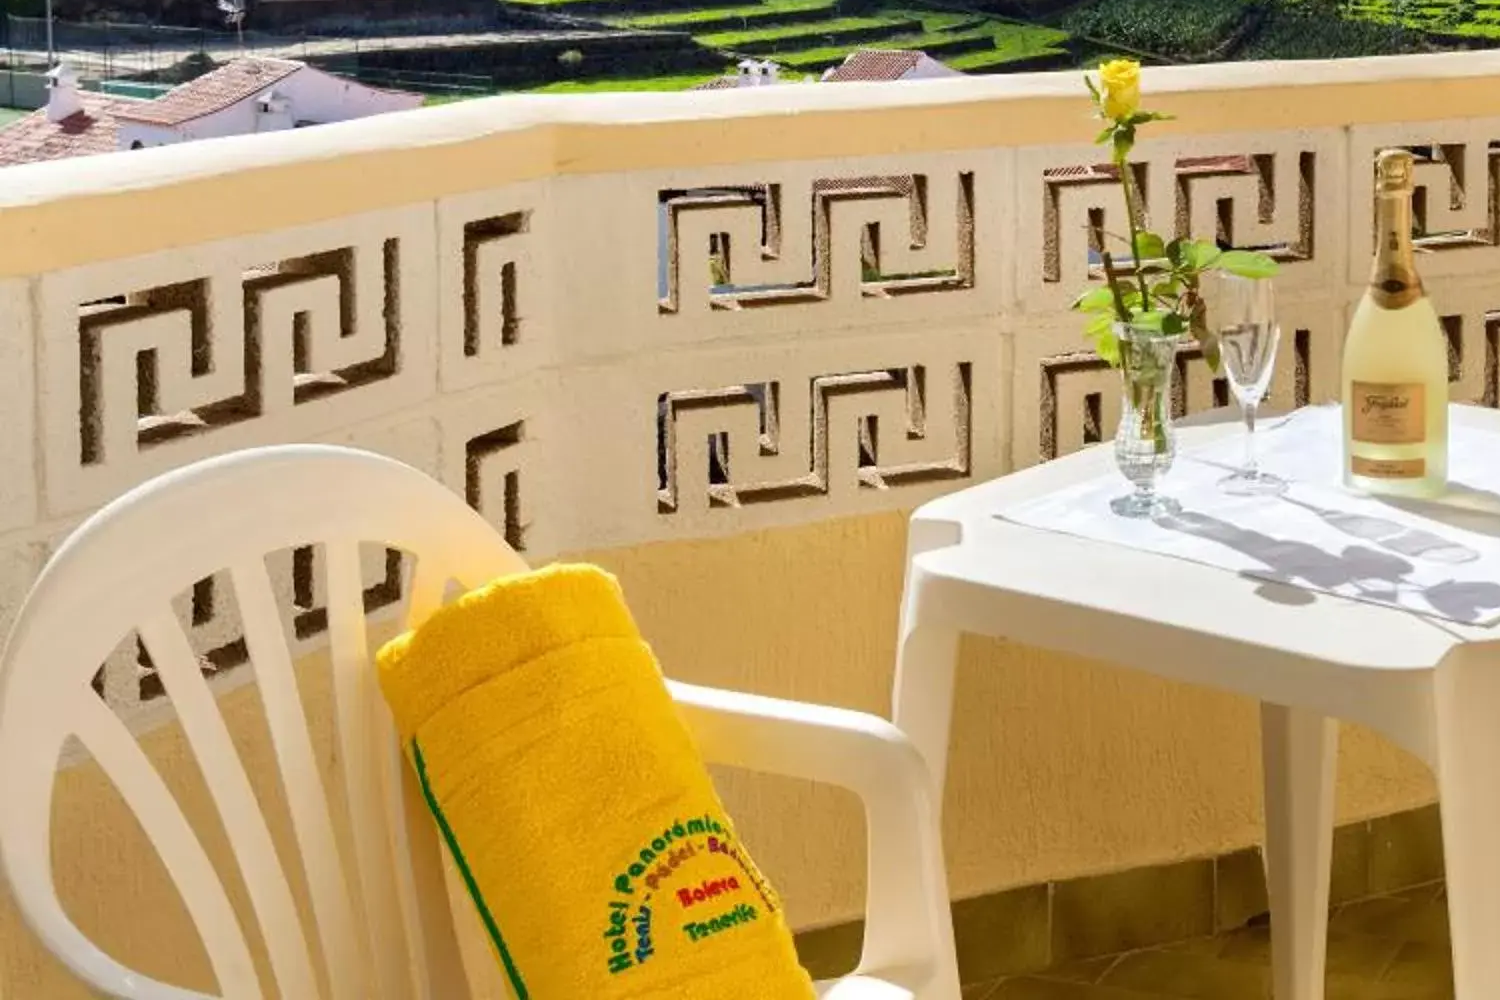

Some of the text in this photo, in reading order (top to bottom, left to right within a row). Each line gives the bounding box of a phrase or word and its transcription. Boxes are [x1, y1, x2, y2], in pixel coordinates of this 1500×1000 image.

[603, 901, 633, 974] Hotel
[632, 905, 655, 964] Tenis
[682, 903, 758, 942] Tenerife
